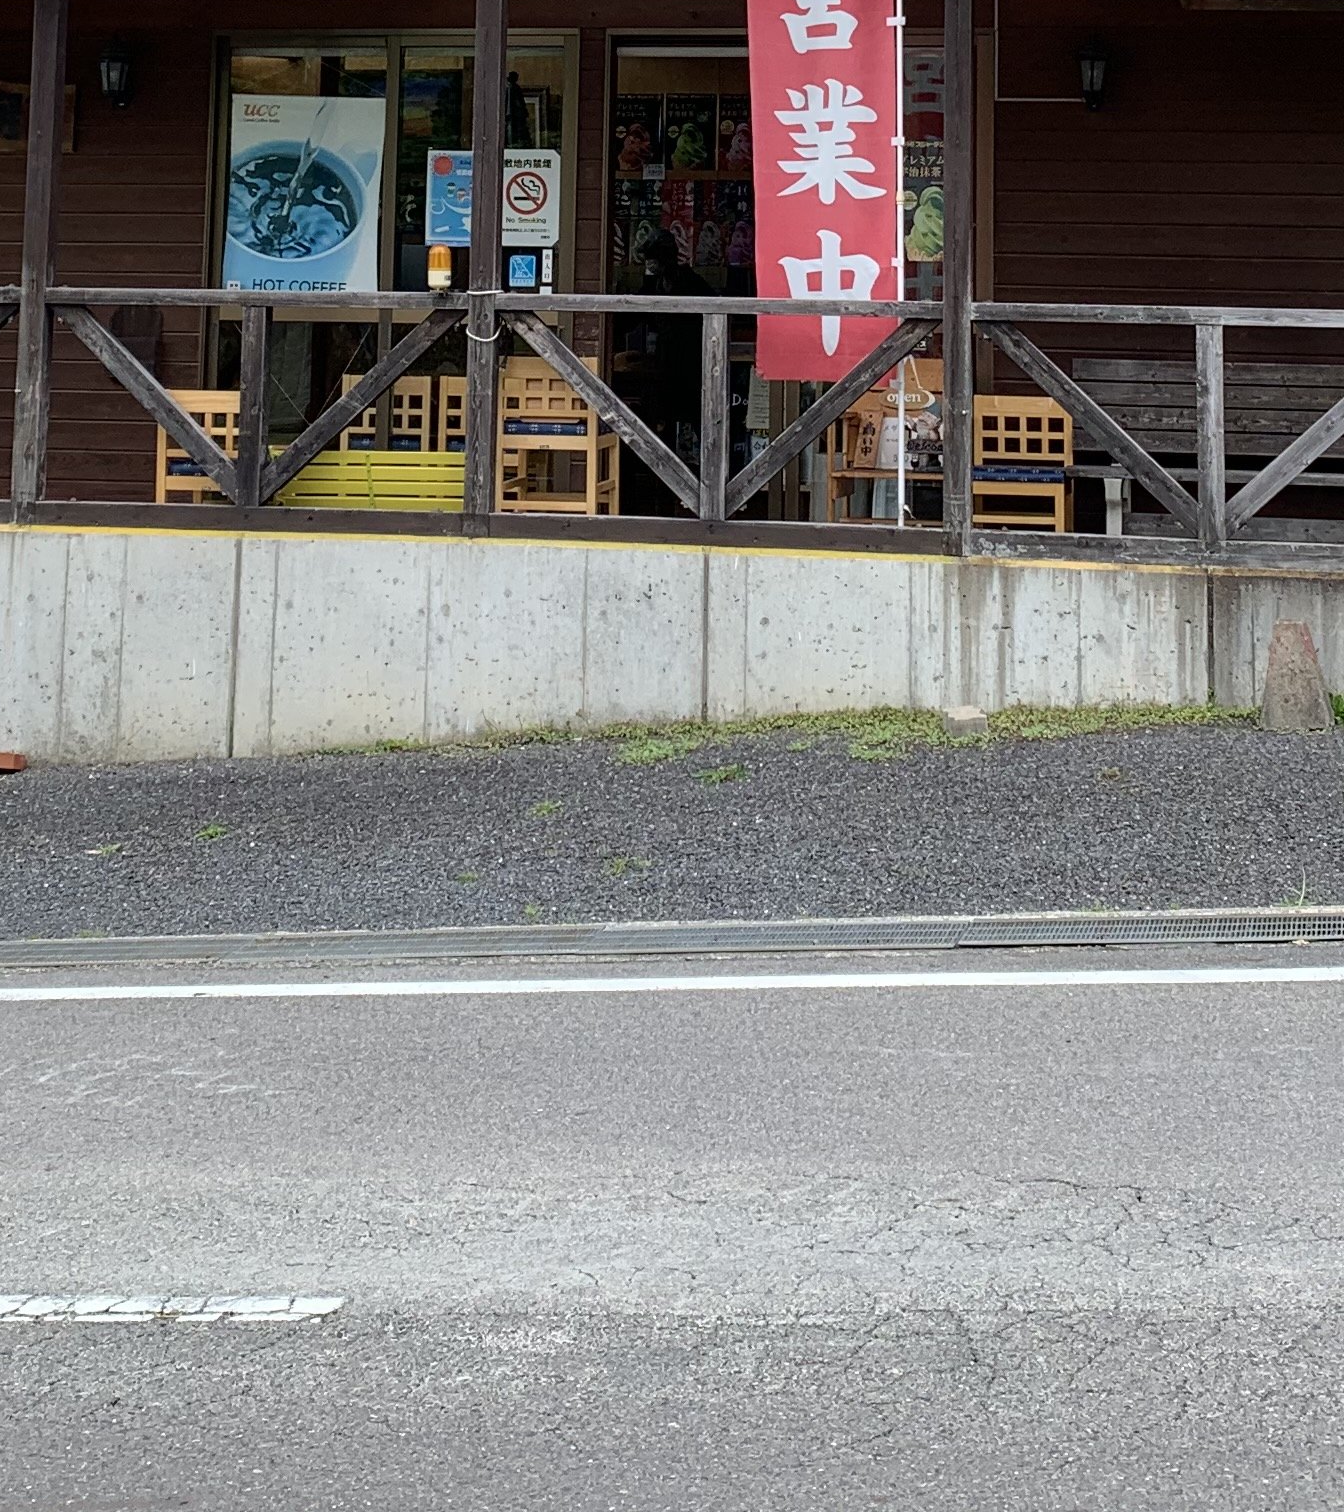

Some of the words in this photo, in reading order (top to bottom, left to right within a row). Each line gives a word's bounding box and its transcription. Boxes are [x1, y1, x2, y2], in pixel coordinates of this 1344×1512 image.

[505, 216, 515, 224] No
[518, 216, 547, 225] Smoking
[252, 278, 285, 291] HOT
